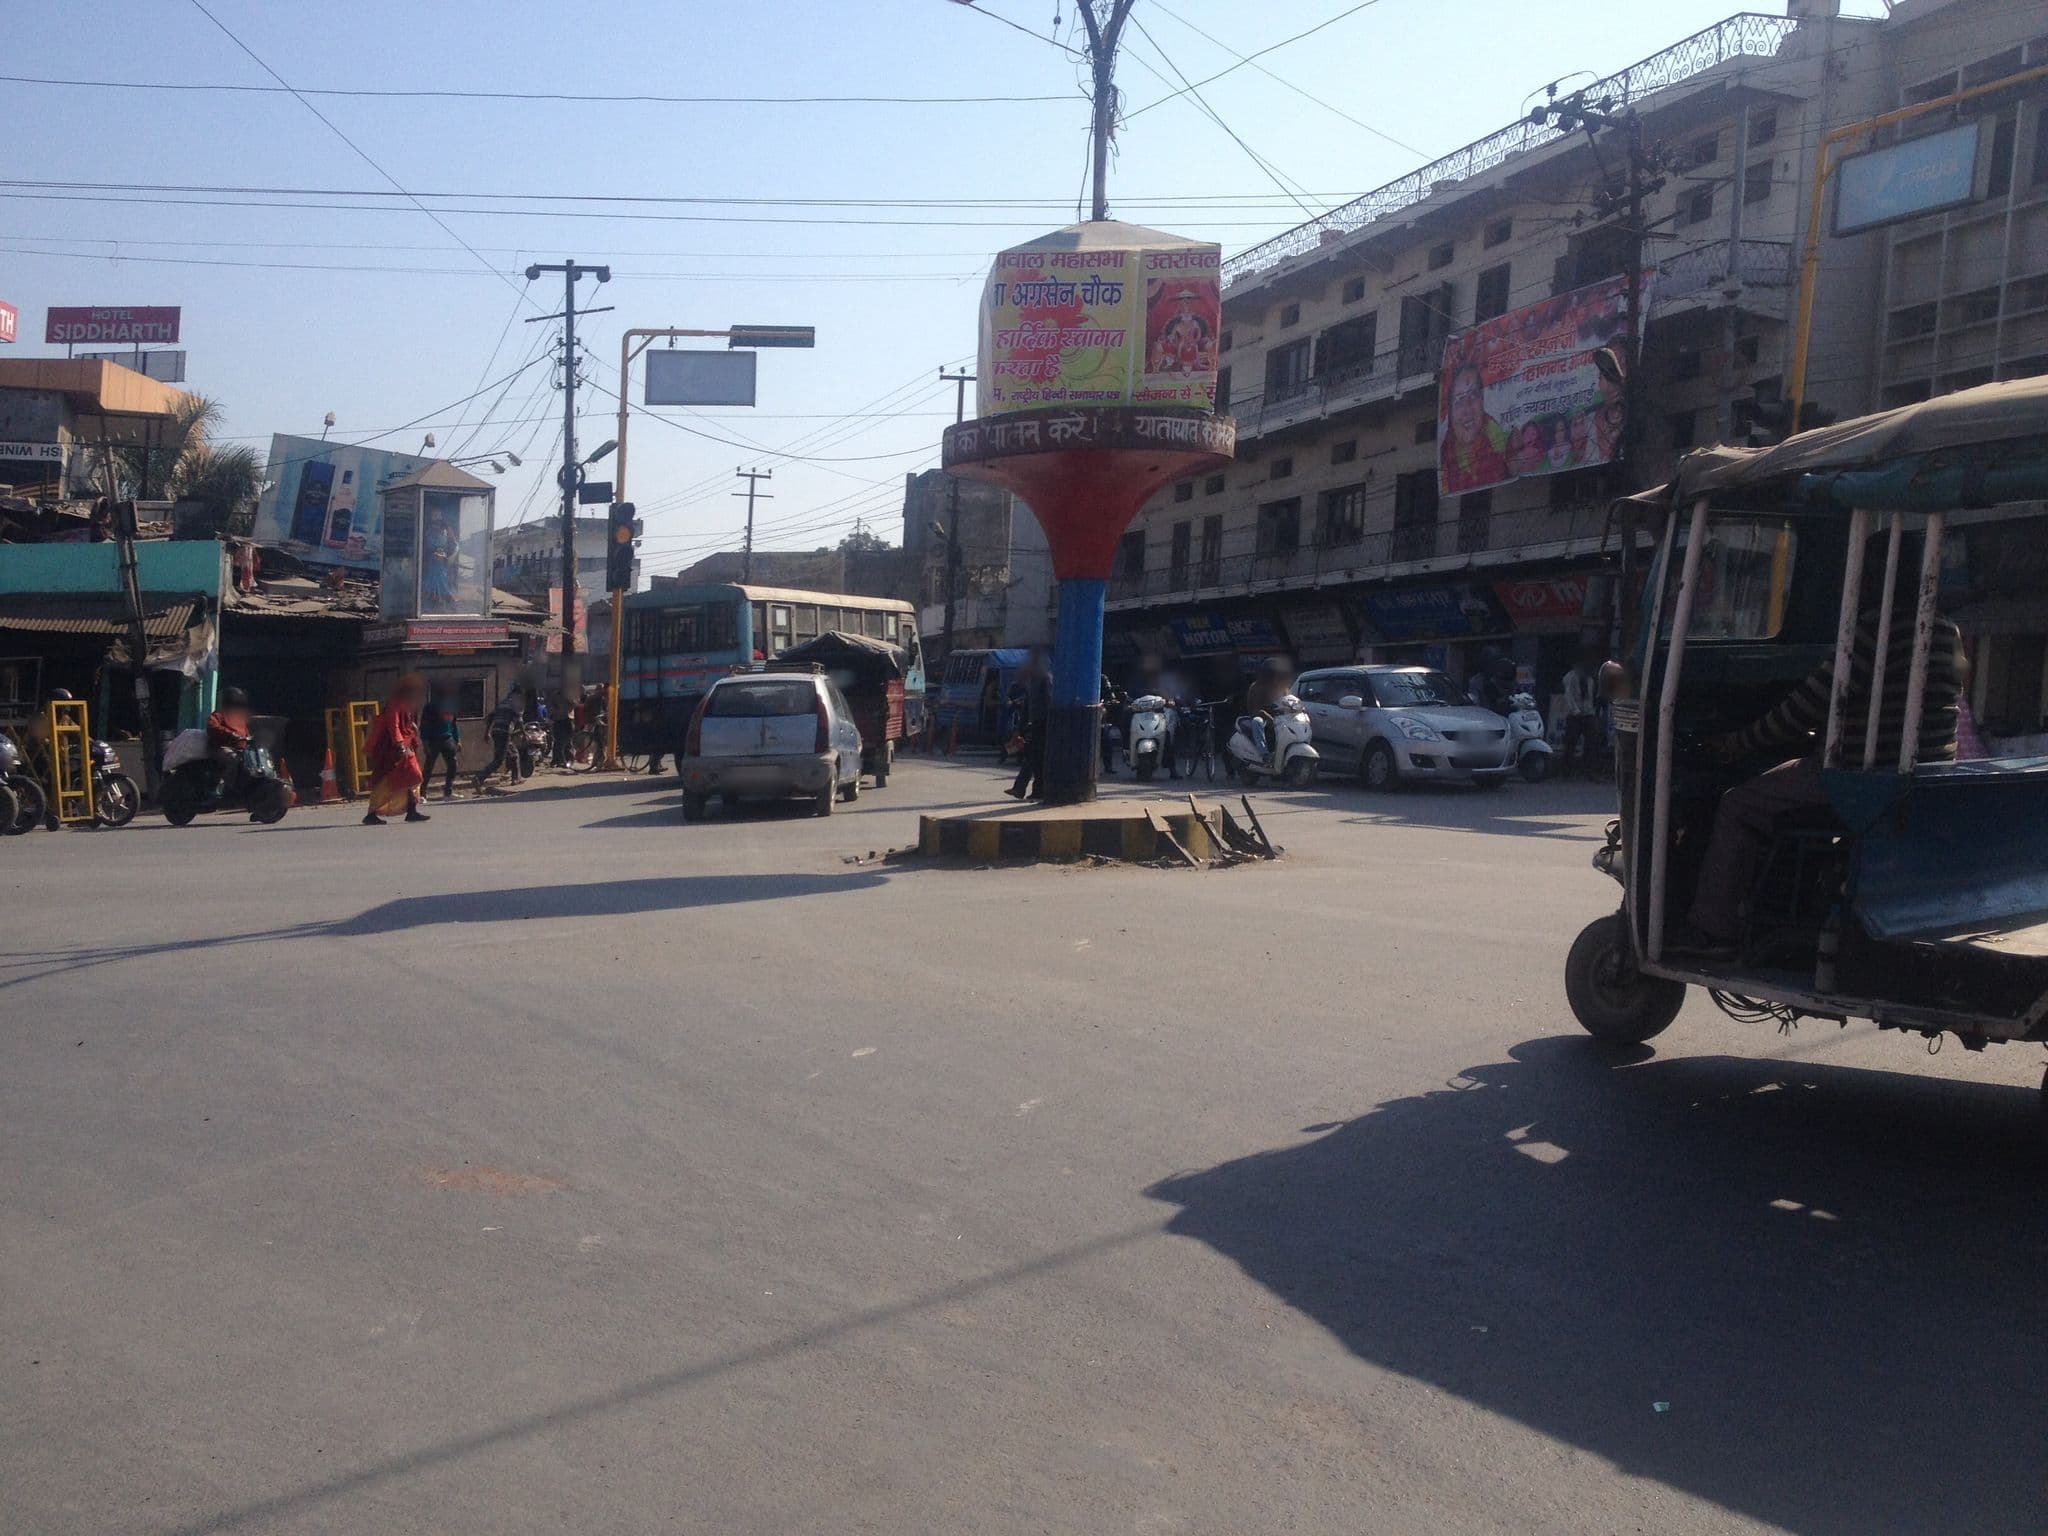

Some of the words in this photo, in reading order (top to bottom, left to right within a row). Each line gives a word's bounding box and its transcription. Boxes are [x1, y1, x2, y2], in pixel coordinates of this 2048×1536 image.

[1050, 250, 1126, 270] महासभा
[1012, 275, 1078, 308] अग्रसेन
[1082, 274, 1123, 307] चौक
[92, 310, 134, 320] HOTEL
[54, 322, 173, 341] SIDDHARTH
[996, 320, 1060, 350] हार्दिक
[1060, 327, 1127, 348] स्वागत
[1041, 387, 1068, 401] हिन्दी
[1069, 390, 1105, 401] समाचार
[1180, 384, 1192, 400] से
[1135, 416, 1201, 442] यातायात
